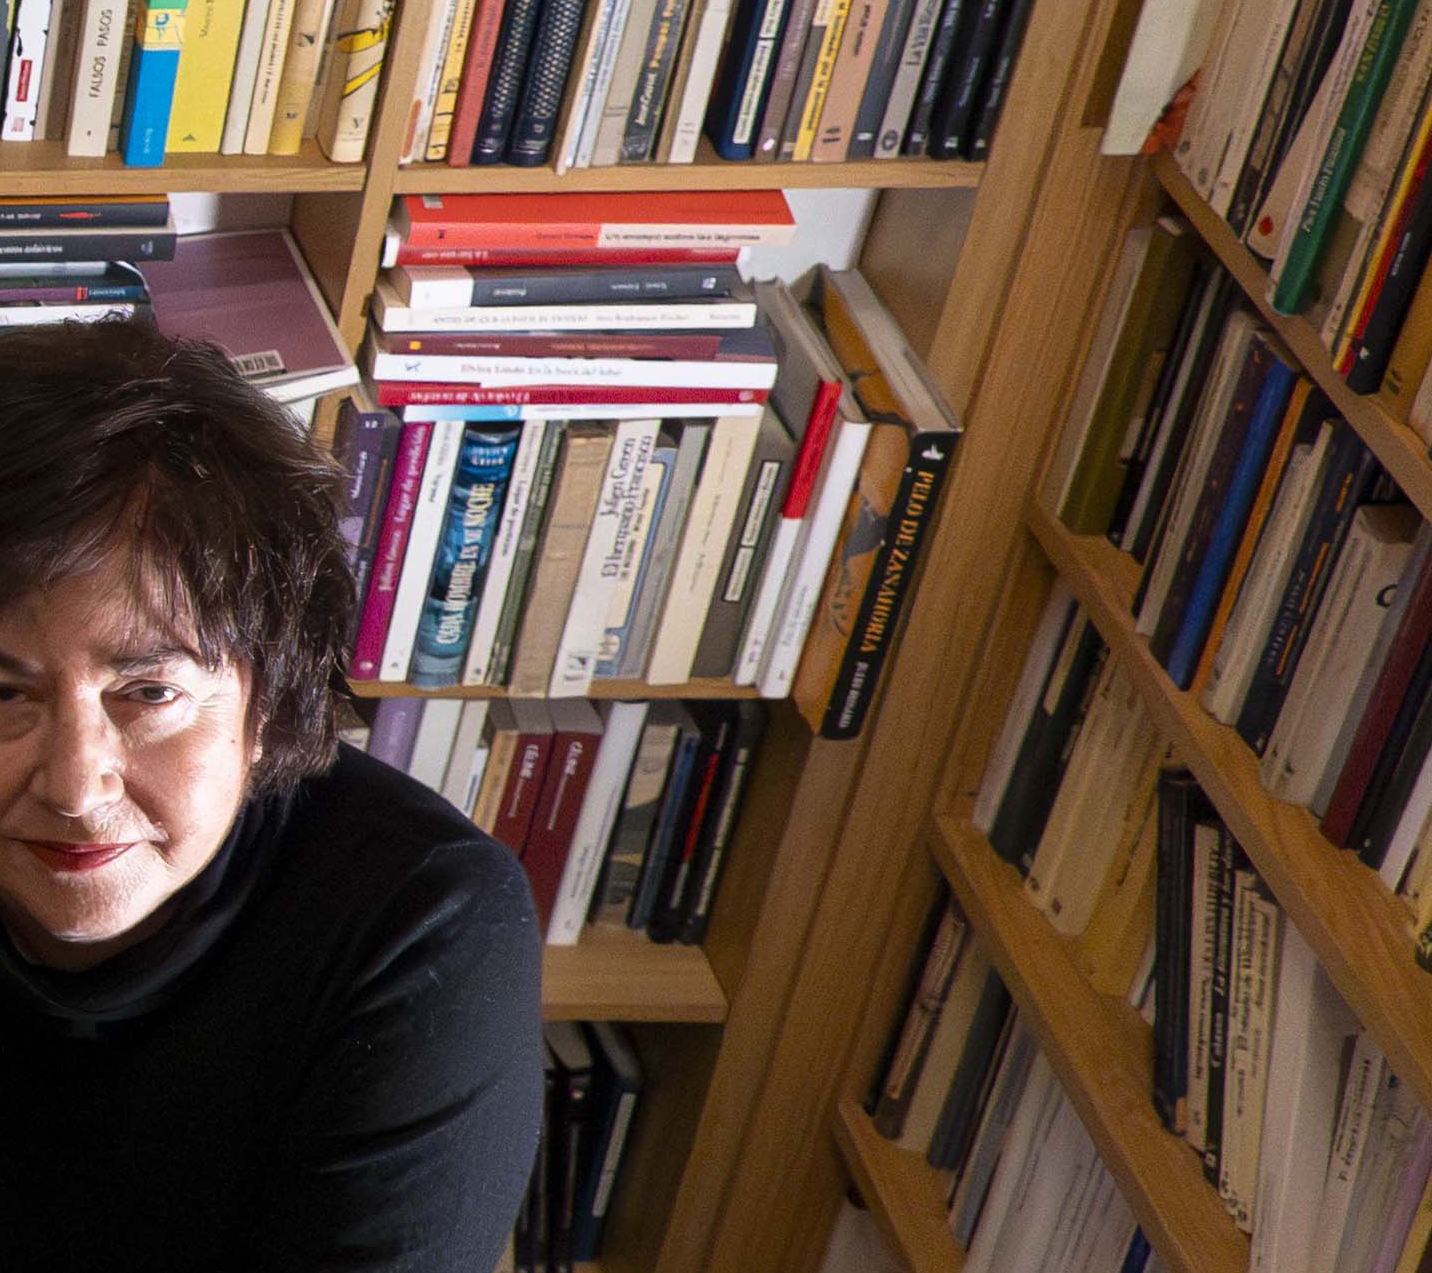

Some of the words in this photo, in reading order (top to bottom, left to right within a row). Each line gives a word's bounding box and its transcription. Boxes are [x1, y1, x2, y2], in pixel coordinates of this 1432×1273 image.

[96, 8, 114, 47] PASOS
[88, 54, 107, 98] FALSOS
[903, 471, 935, 517] PELO
[894, 519, 921, 544] DE
[436, 612, 465, 644] CADA
[464, 482, 495, 527] NOCHE
[859, 548, 911, 652] ZANAHORIA
